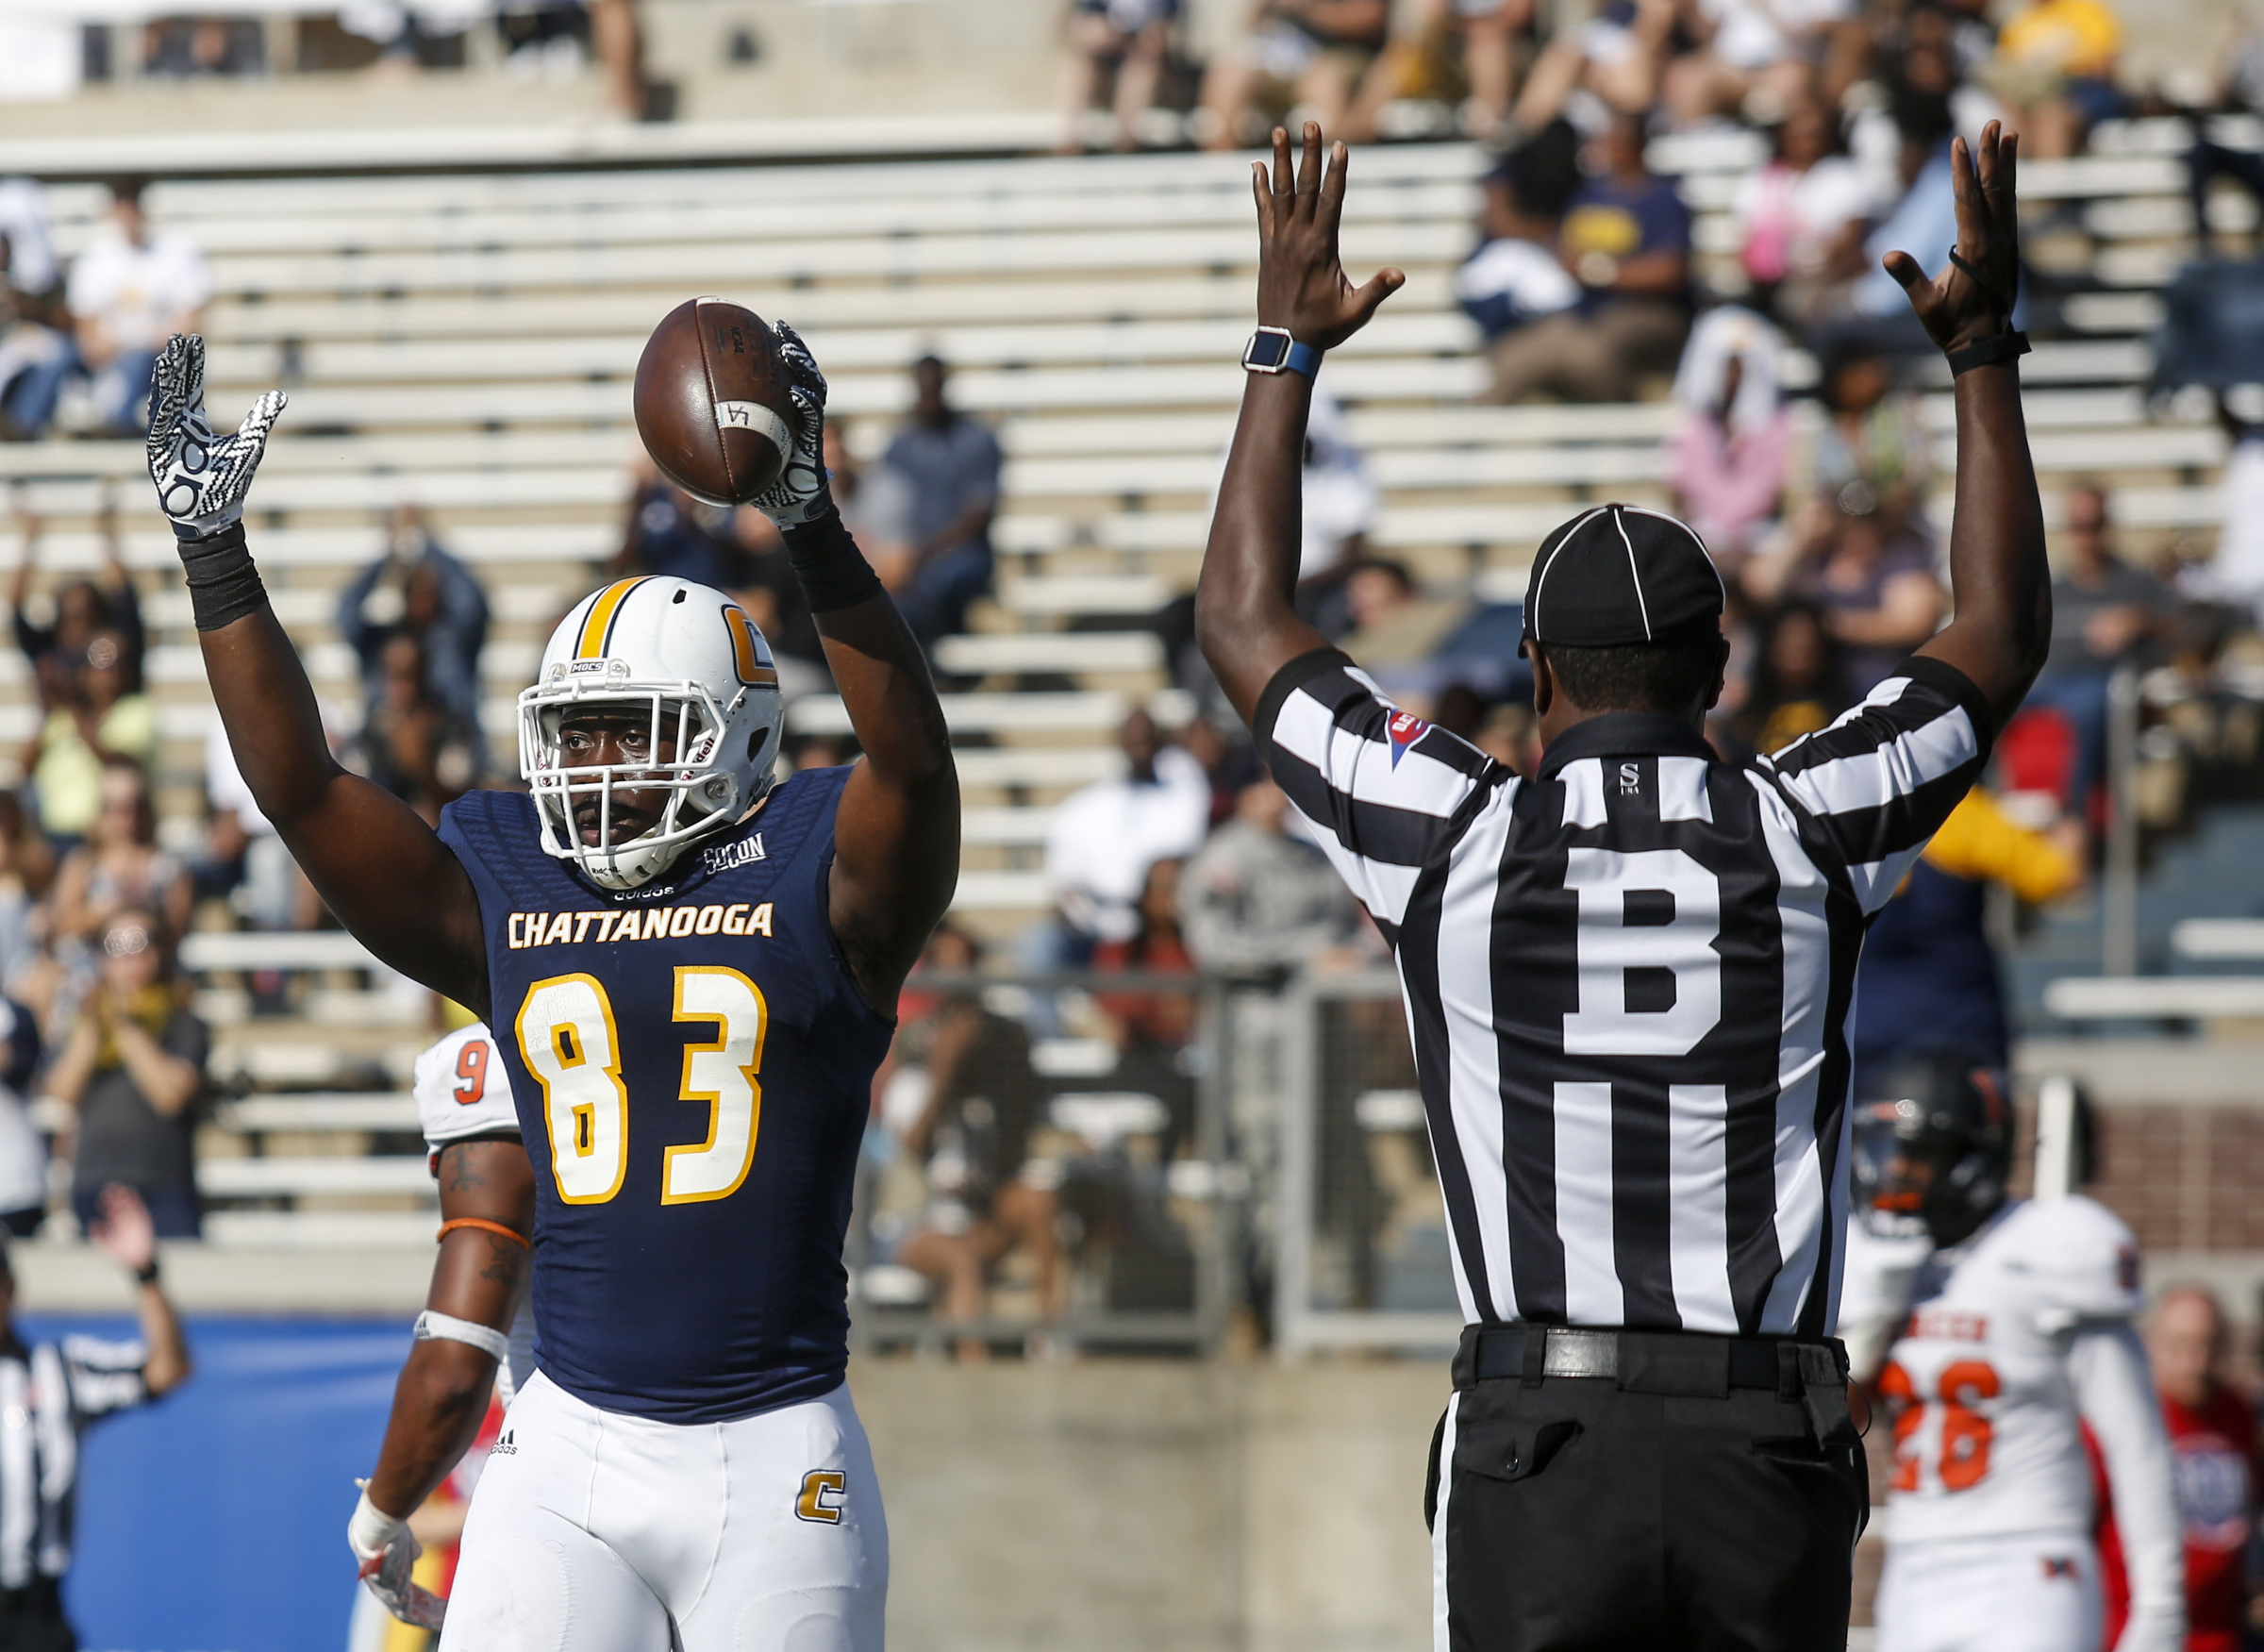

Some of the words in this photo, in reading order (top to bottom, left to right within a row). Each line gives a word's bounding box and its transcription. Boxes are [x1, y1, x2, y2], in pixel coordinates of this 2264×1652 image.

[572, 662, 603, 673] MOCS
[703, 831, 767, 876] SOCON
[614, 887, 674, 901] adidas
[508, 902, 774, 950] CHATTANOOGA
[1563, 847, 1721, 1056] B
[454, 1040, 490, 1106] 9
[514, 965, 768, 1206] 83
[1877, 1360, 2000, 1493] 26
[794, 1468, 846, 1526] C
